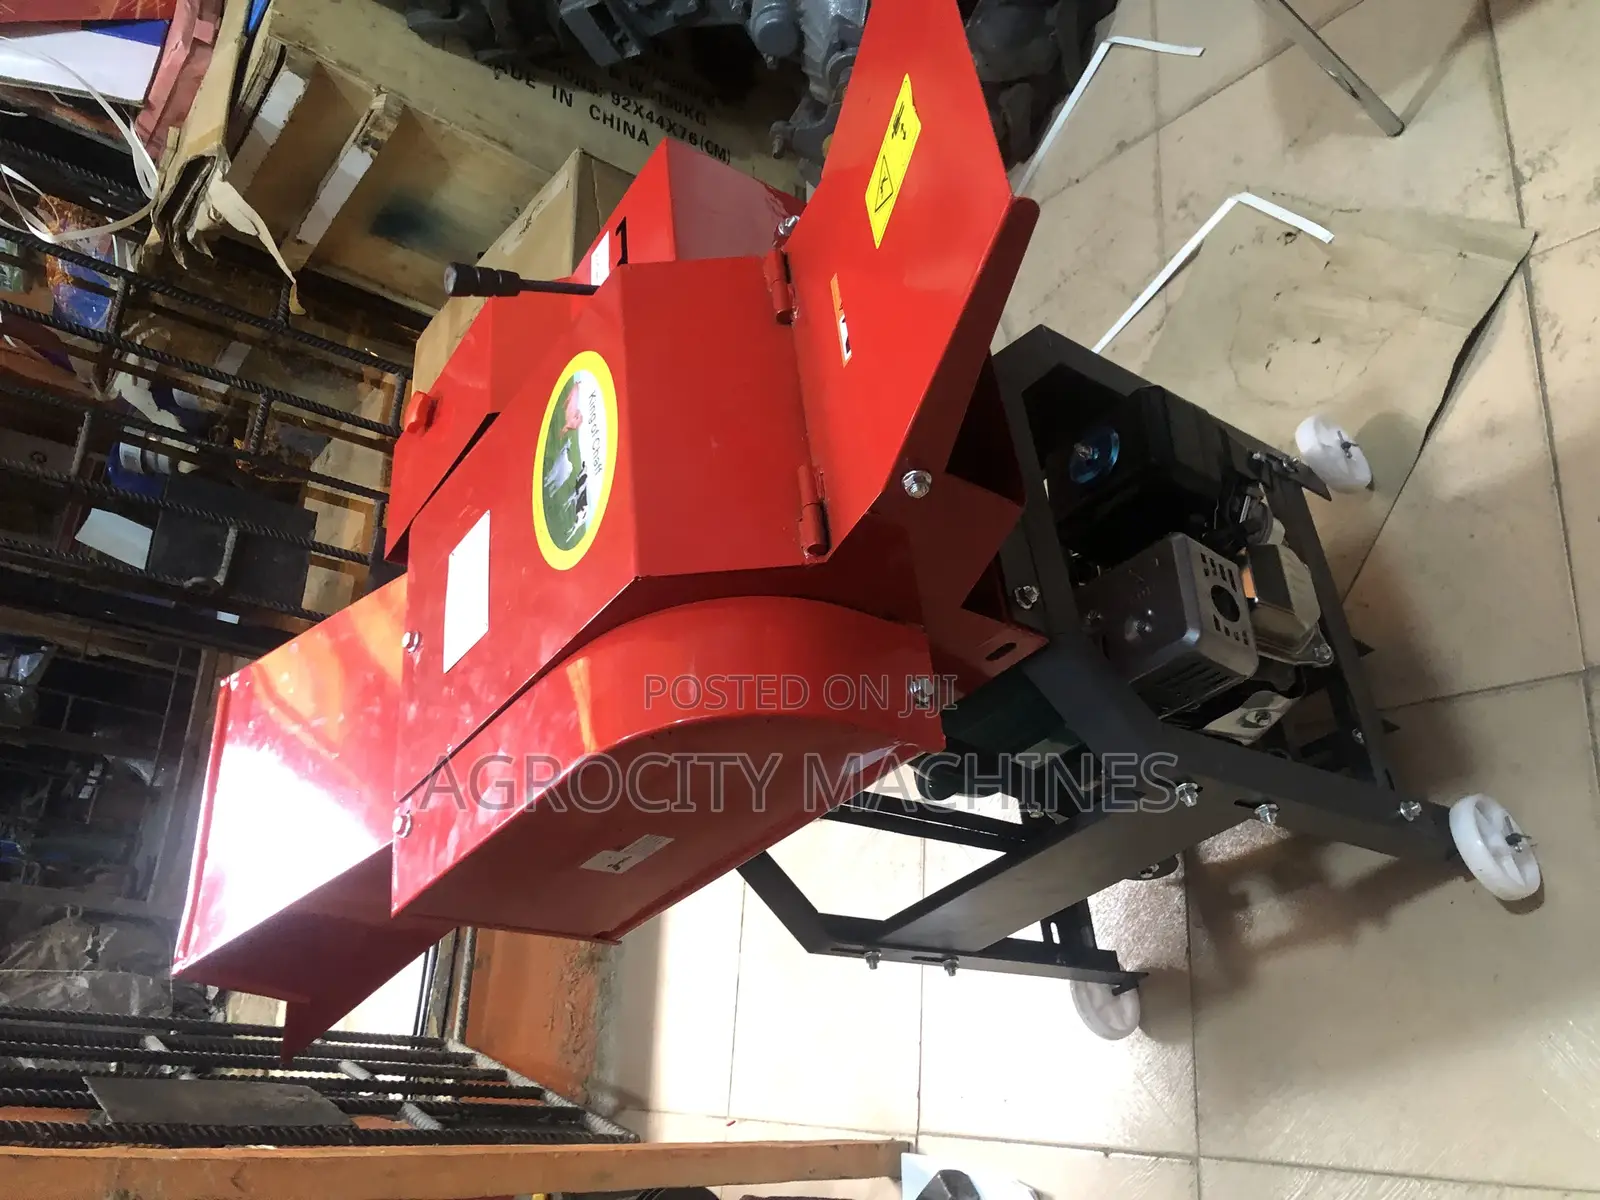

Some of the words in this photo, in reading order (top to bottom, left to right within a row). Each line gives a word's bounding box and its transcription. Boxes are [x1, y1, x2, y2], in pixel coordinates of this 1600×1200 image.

[552, 84, 573, 107] IN
[589, 104, 650, 146] CHINA
[587, 390, 597, 424] King
